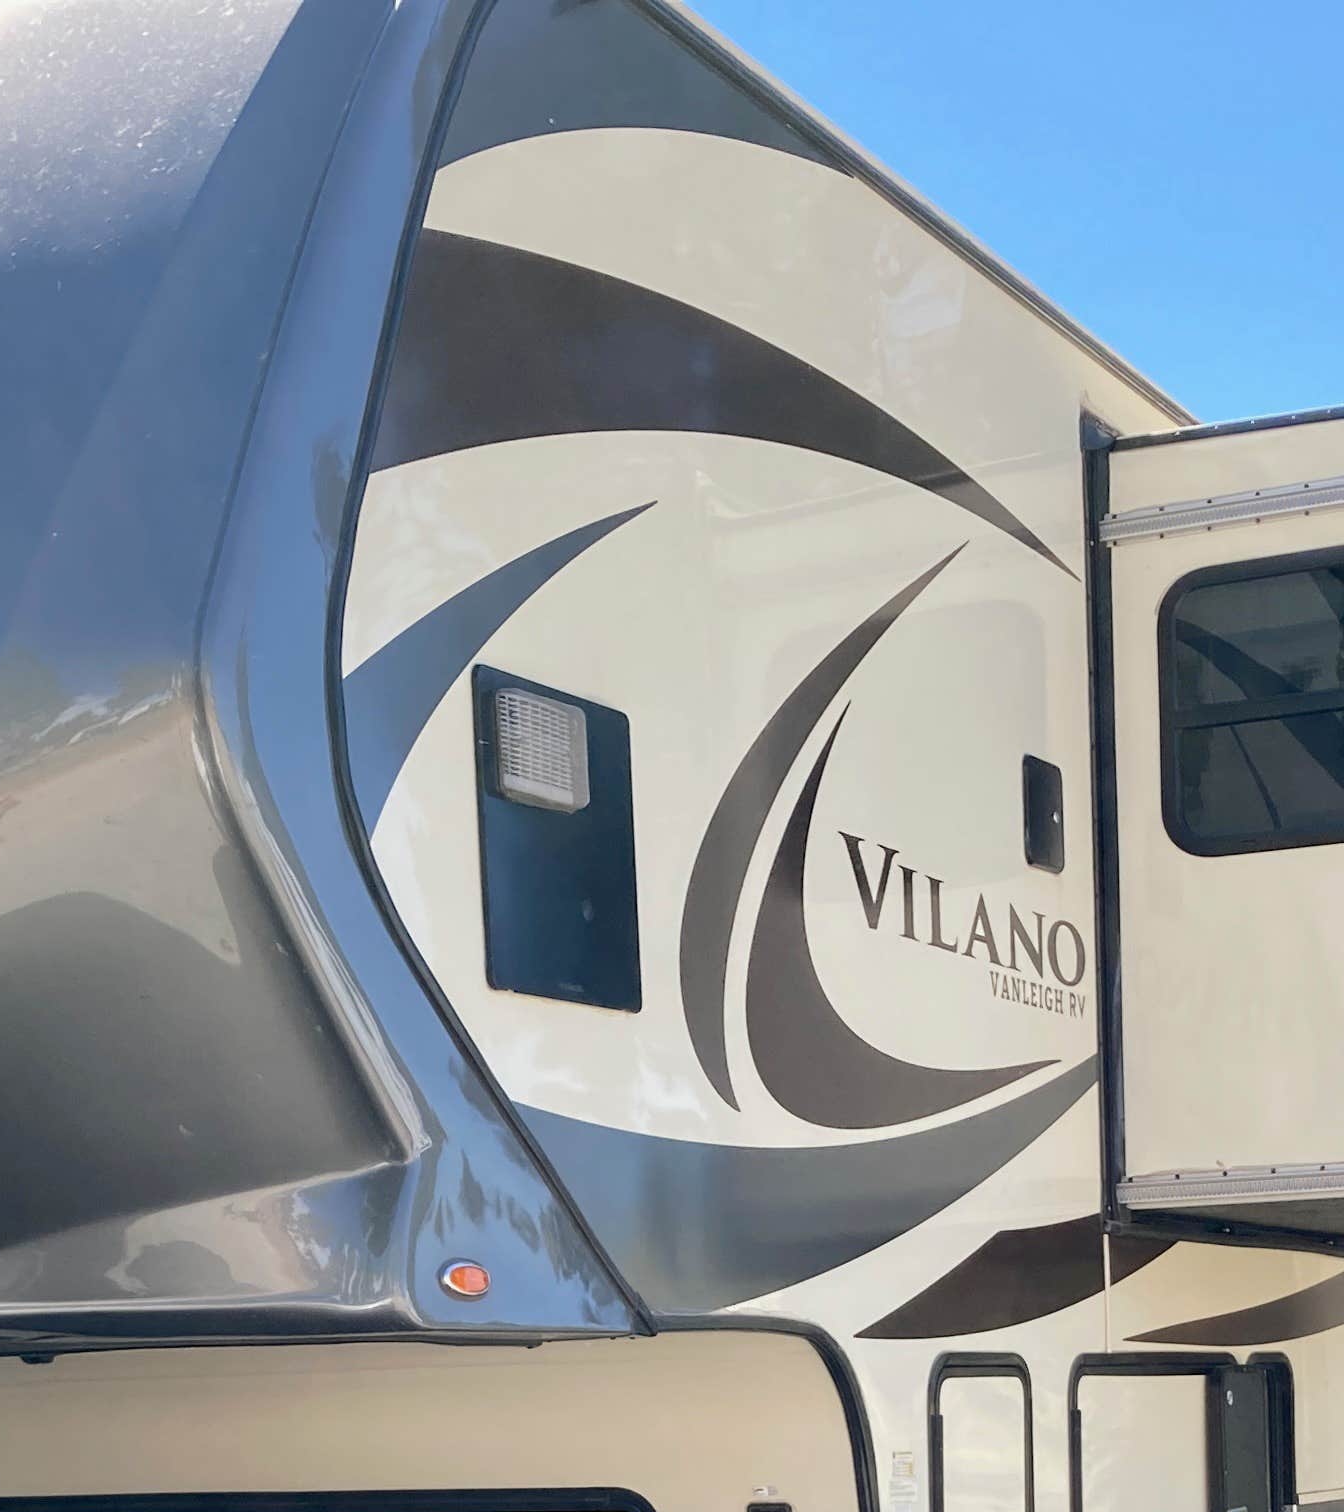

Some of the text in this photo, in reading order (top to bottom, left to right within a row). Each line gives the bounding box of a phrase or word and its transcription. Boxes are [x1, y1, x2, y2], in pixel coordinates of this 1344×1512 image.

[837, 831, 1086, 987] VILANO
[990, 971, 1086, 1017] VANLEIGH RV
